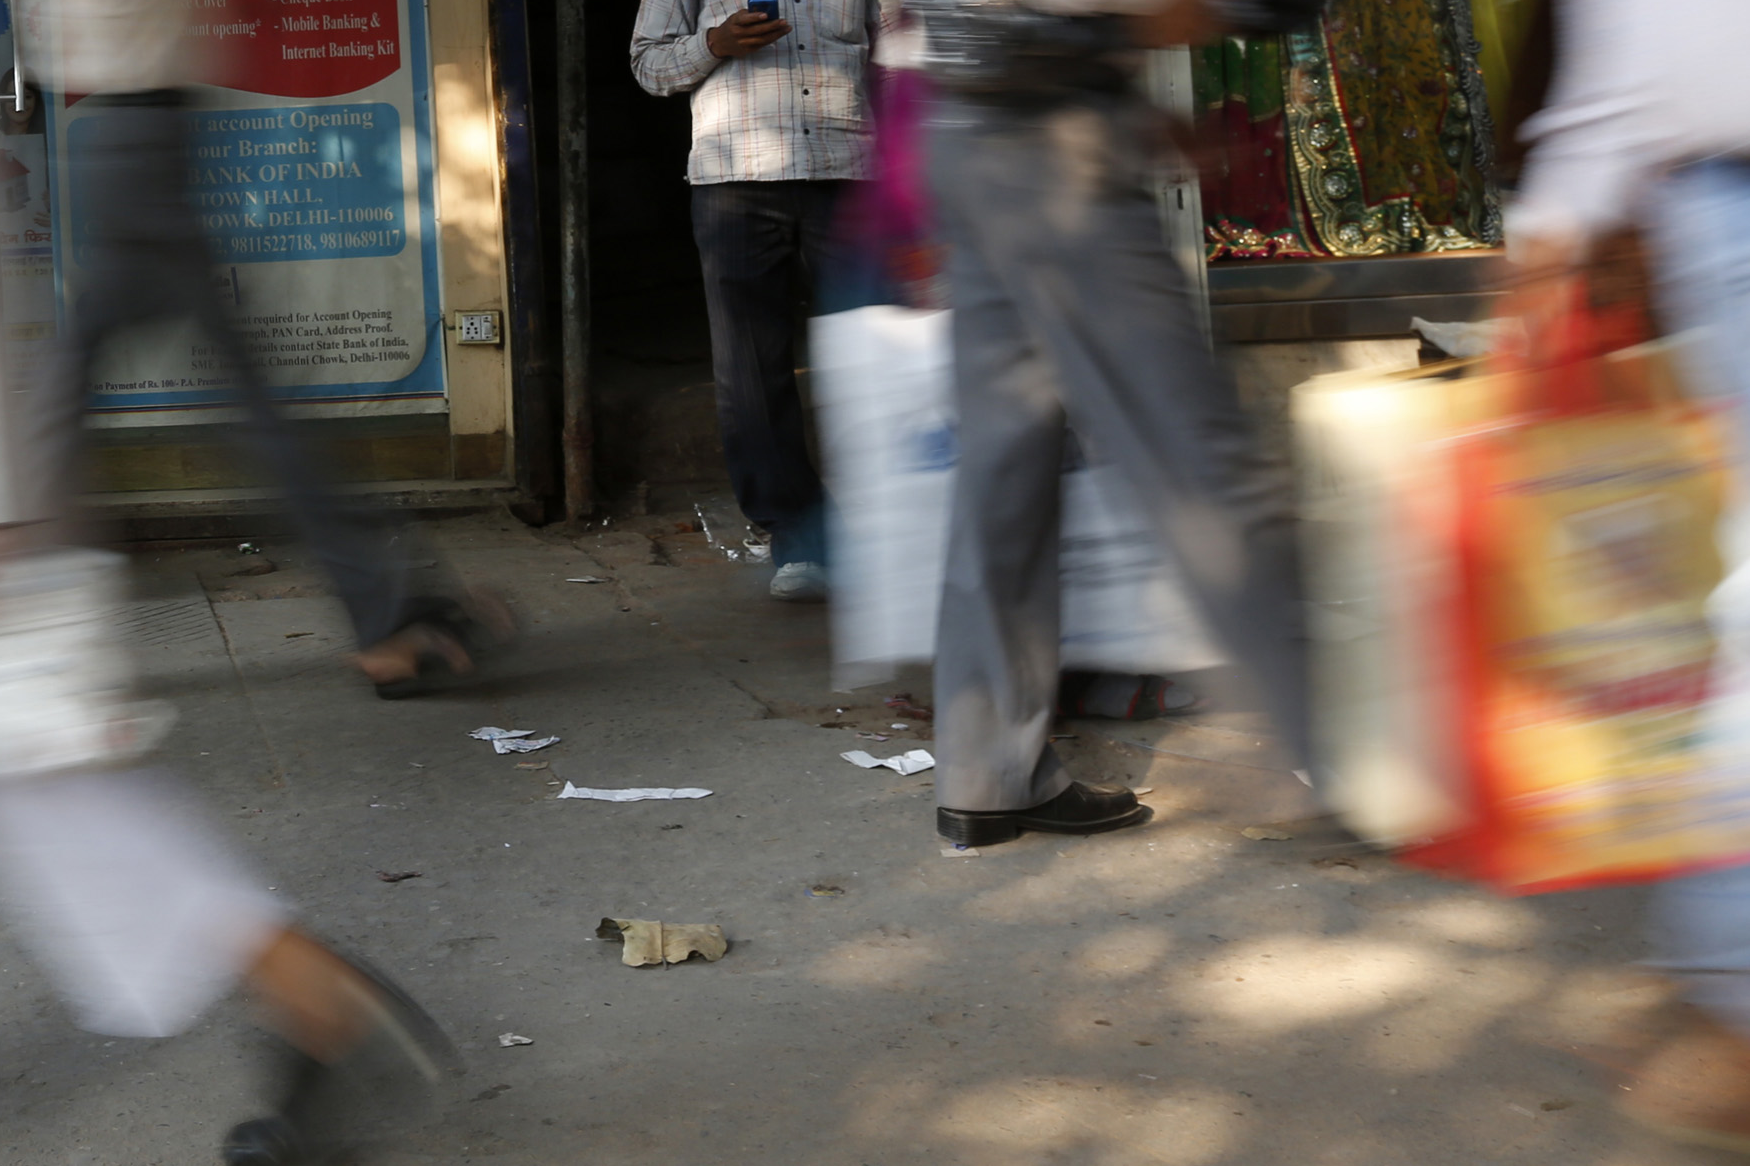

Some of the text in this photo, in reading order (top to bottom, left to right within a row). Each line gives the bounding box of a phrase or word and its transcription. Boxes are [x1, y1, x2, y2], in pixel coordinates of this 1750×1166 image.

[281, 11, 381, 34] Mobile Banking &
[281, 39, 395, 61] Internet Banking Kit
[207, 113, 285, 133] account
[289, 109, 374, 133] Opening
[197, 137, 318, 159] our Branch:
[258, 163, 291, 183] OF
[295, 160, 363, 182] INDIA
[198, 190, 258, 208] TOWN
[268, 206, 394, 228] DELHI-110006
[252, 312, 294, 326] required
[295, 311, 311, 323] for
[311, 310, 350, 323] Account
[352, 308, 393, 321] Opening
[272, 327, 294, 339] PAN
[323, 323, 363, 337] Address
[280, 340, 315, 353] contact
[316, 339, 341, 351] State
[342, 338, 367, 350] Bank
[368, 337, 381, 349] of
[268, 354, 310, 367] Chandni
[349, 350, 410, 364] Delhi-110006
[104, 380, 137, 393] Payment
[138, 380, 148, 390] of
